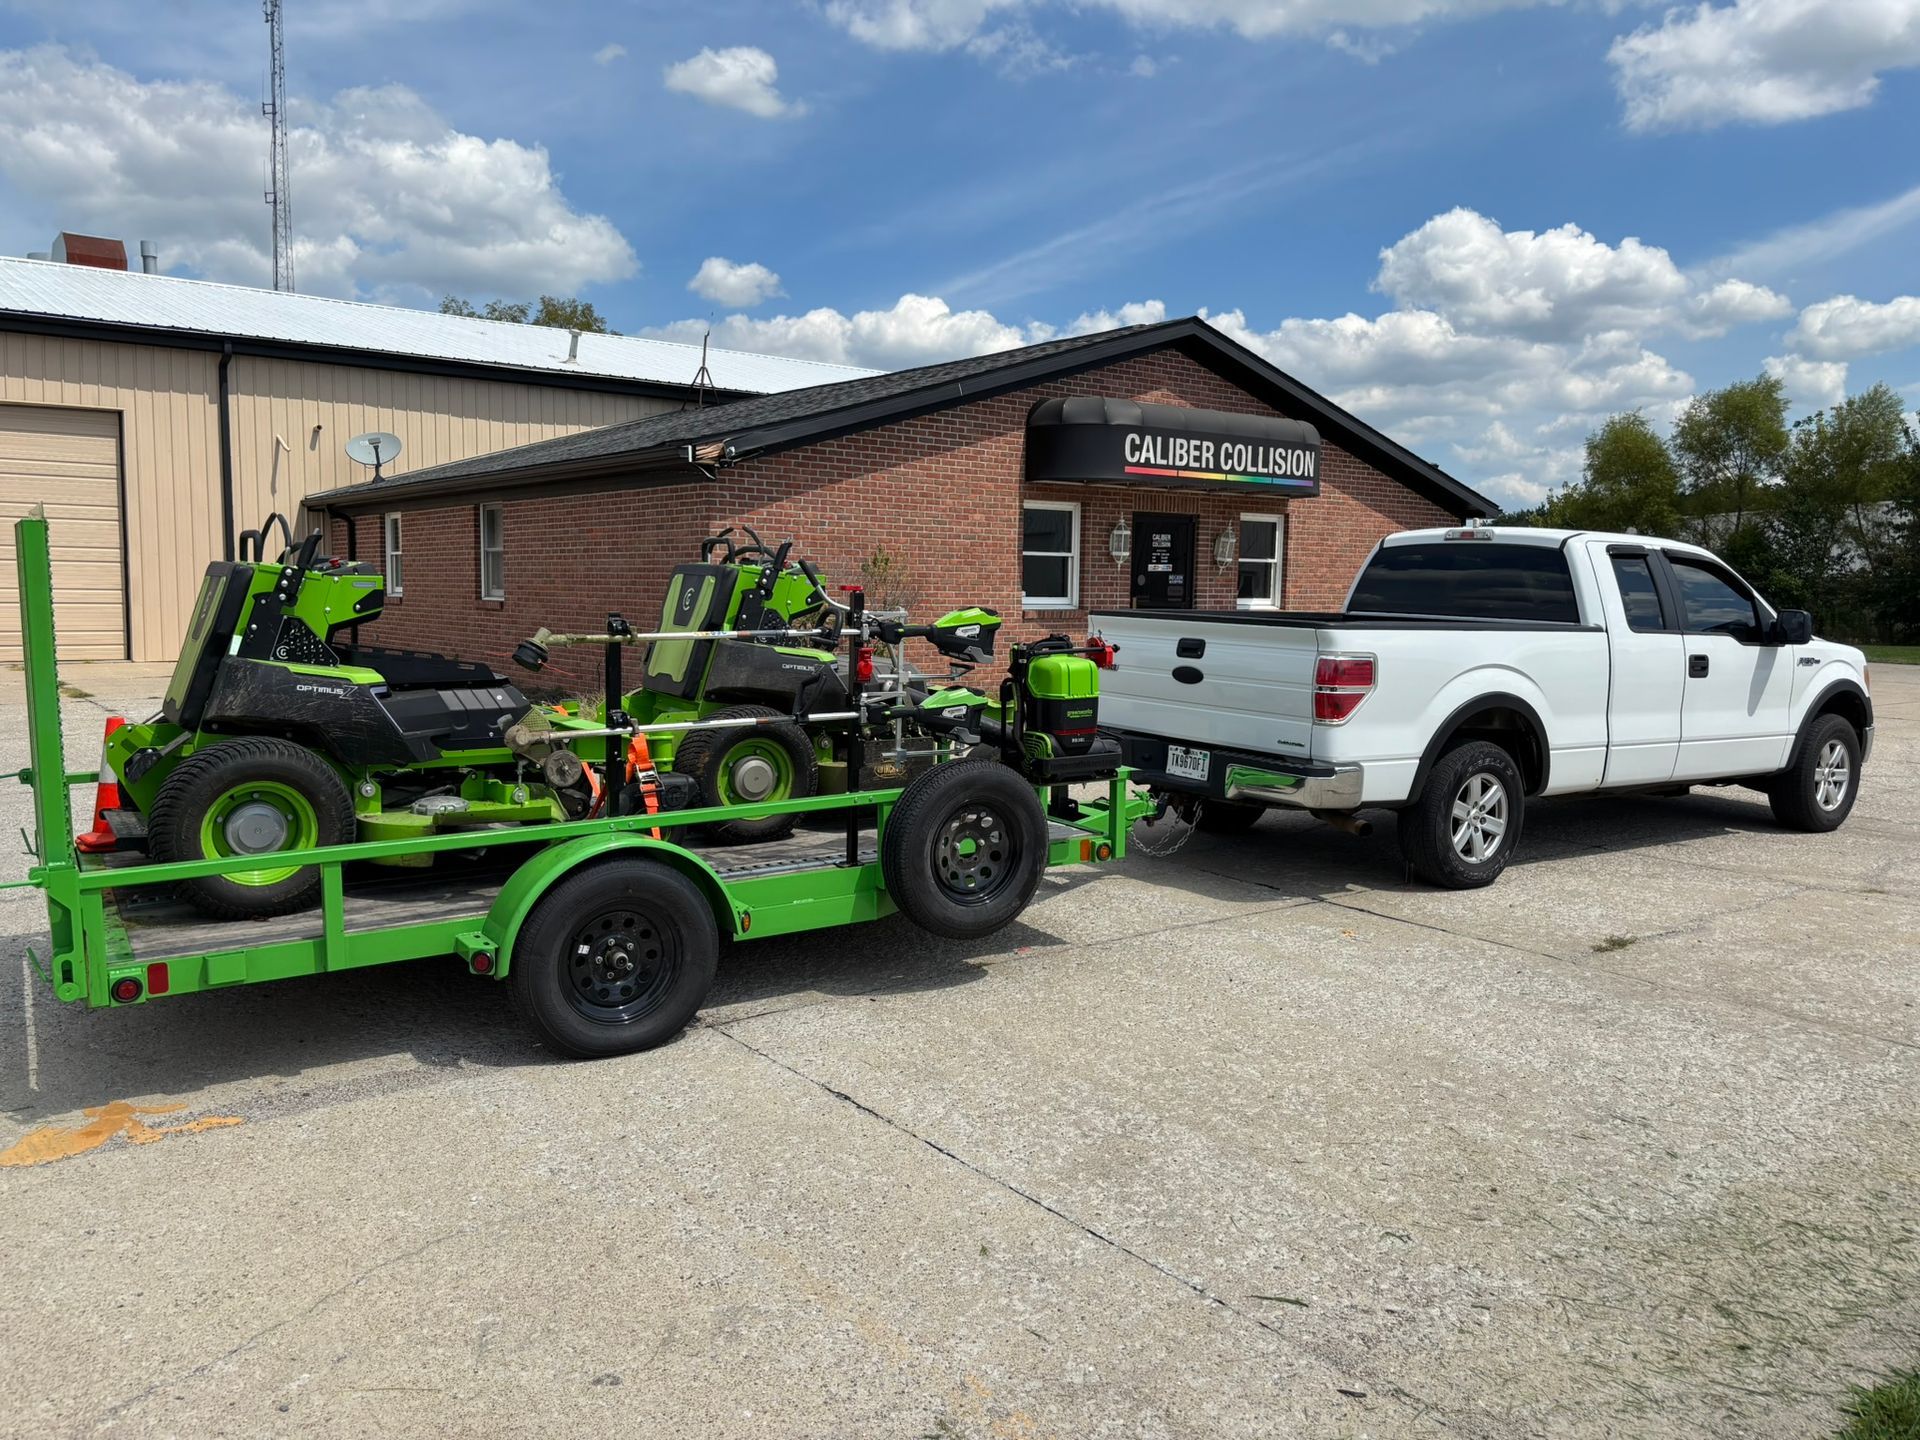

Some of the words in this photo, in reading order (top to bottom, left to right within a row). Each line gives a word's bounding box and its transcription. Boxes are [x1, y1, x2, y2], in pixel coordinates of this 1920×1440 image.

[1125, 433, 1214, 469] CALIBER
[1220, 442, 1315, 477] COLLISION
[1152, 533, 1171, 541] CALIBER
[296, 684, 344, 695] OPTIMUS
